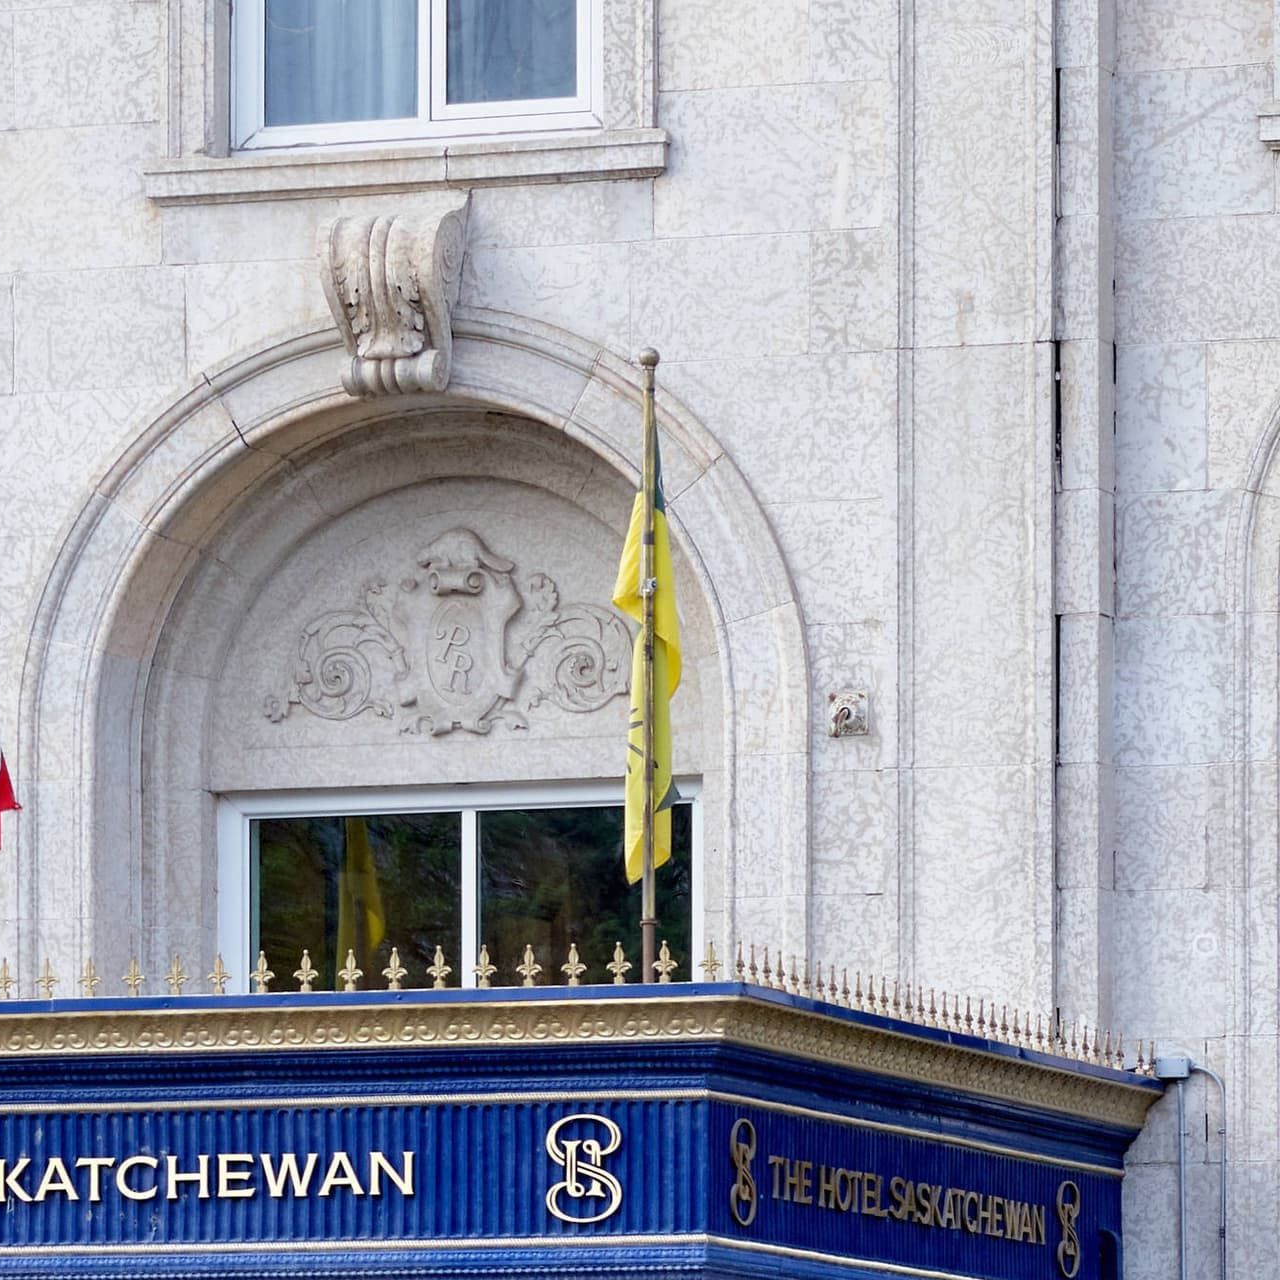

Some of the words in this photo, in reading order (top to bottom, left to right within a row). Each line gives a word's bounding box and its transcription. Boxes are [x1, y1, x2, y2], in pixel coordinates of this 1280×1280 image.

[768, 1155, 813, 1205] THE
[818, 1165, 889, 1218] HOTEL
[889, 1176, 1046, 1246] SASKATCHEWAN
